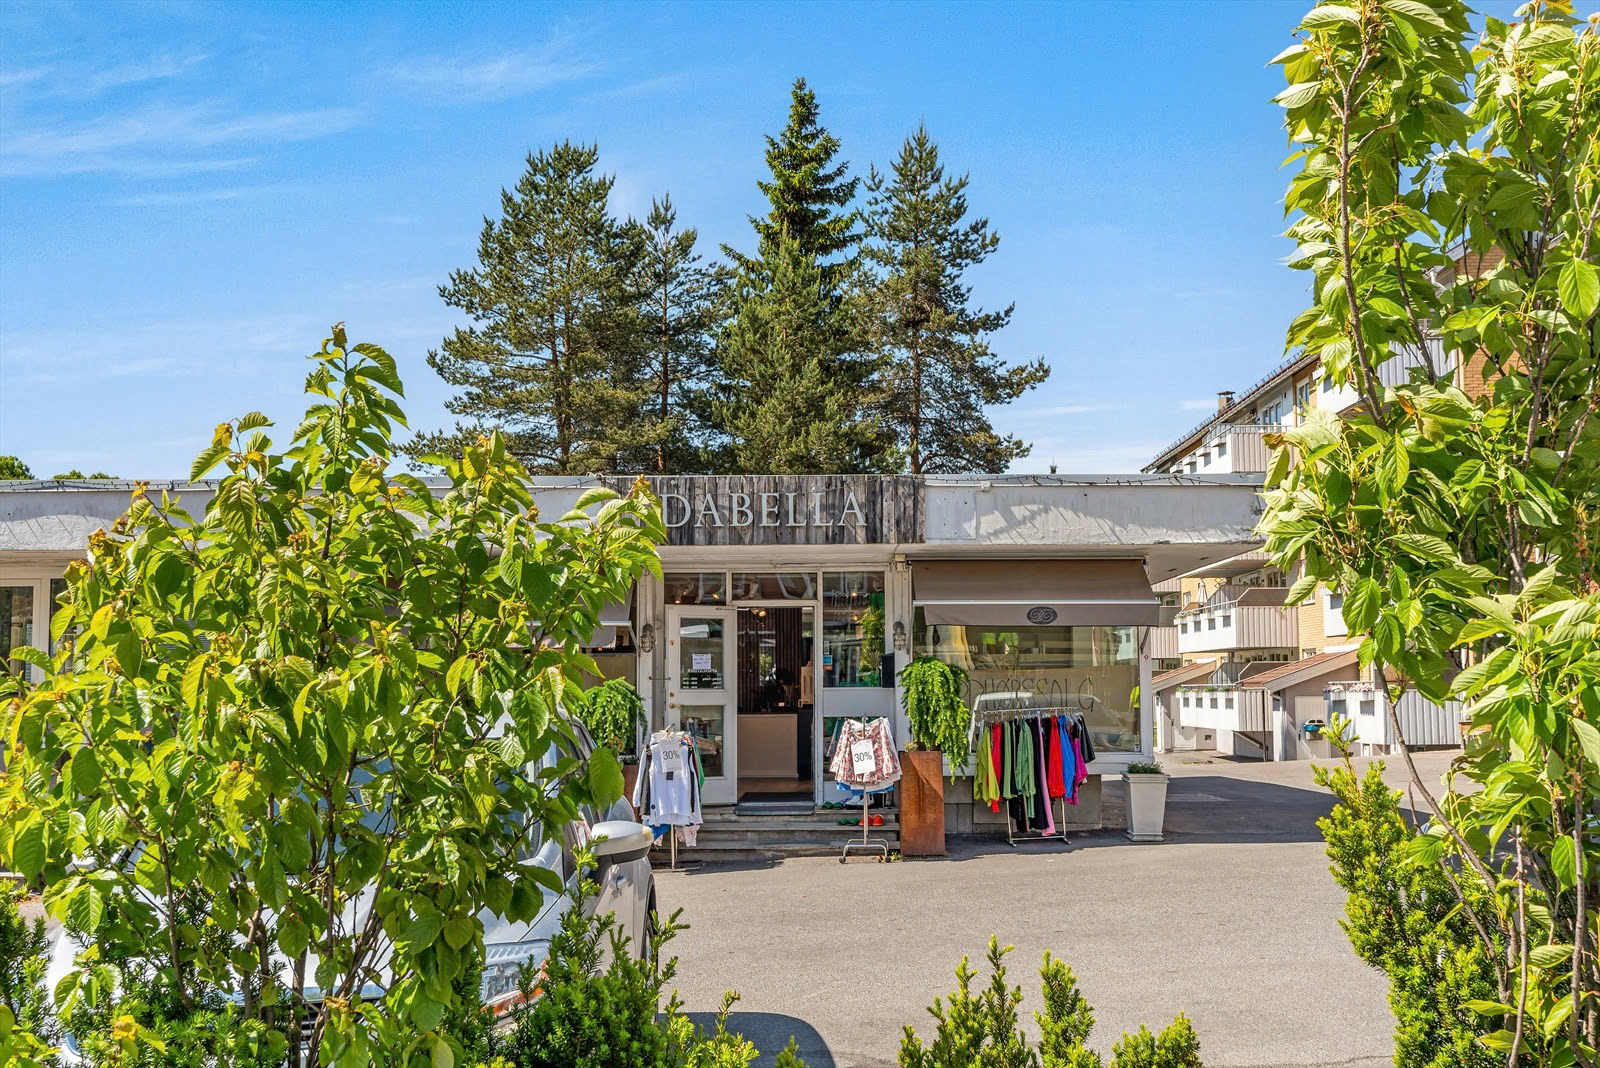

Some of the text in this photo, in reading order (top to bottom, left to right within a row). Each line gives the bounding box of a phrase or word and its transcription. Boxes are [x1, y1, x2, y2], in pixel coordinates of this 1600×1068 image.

[659, 492, 867, 528] DABELLA
[662, 750, 681, 761] 30%
[854, 751, 873, 763] 30%
